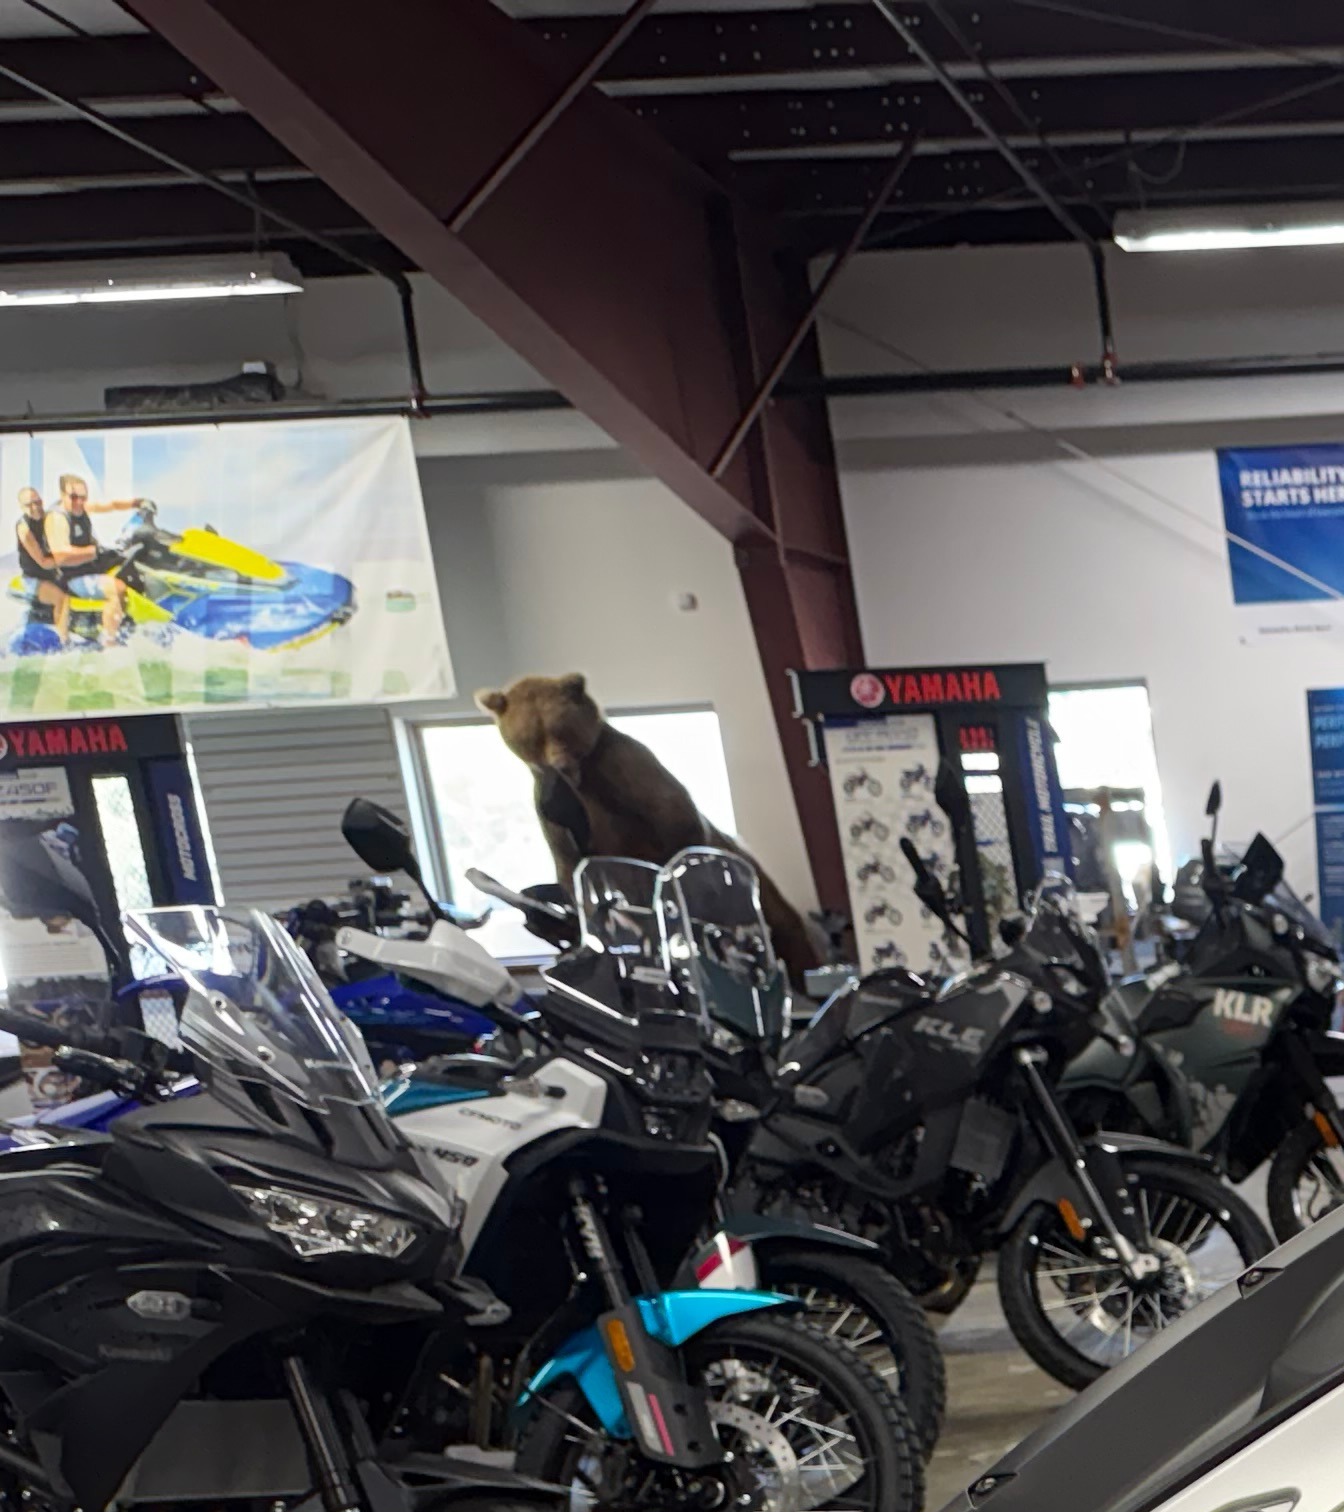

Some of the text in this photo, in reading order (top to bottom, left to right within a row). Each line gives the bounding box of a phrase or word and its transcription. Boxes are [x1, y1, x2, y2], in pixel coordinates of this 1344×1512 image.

[1241, 487, 1311, 508] STARTS
[882, 670, 1001, 705] YAMAHA
[8, 722, 128, 757] YAMAHA
[1212, 987, 1273, 1028] KLR
[433, 1148, 479, 1167] 450
